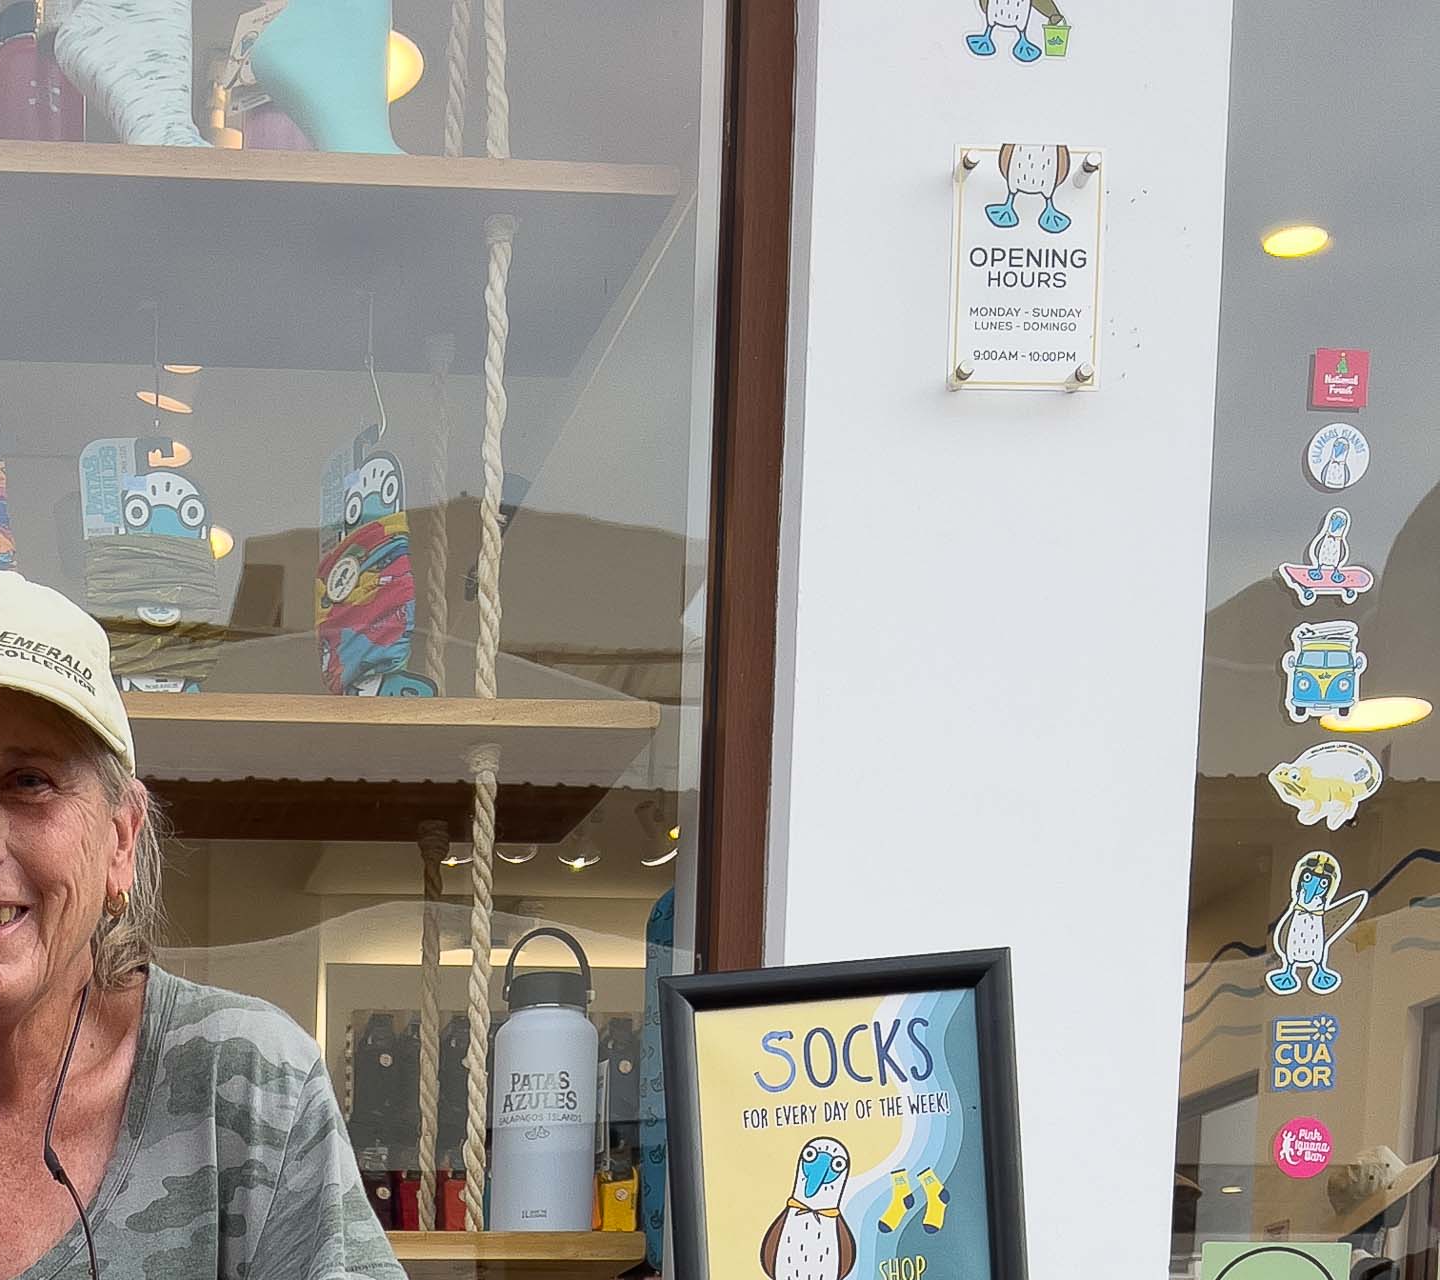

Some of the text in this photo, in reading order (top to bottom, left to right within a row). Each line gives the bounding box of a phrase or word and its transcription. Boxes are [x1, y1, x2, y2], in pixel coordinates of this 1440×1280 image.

[969, 247, 1087, 269] OPENING
[987, 271, 1067, 288] HOURS
[969, 306, 1021, 317] MONDAY
[1031, 307, 1082, 318] SUNDAY
[974, 321, 1013, 331] LUNES
[1023, 322, 1077, 331] DOMINGO
[973, 350, 1018, 361] 9:00AM
[1028, 351, 1076, 362] 10:00PM
[1312, 428, 1366, 465] GALAPAGOS ISLANDS
[754, 1017, 935, 1094] SOCKS
[1274, 1043, 1332, 1065] CUA
[510, 1071, 570, 1093] PATAS
[1274, 1066, 1332, 1088] DOR
[502, 1091, 578, 1114] AZULES
[743, 1091, 950, 1129] FOR EVERY DAY OF THE WEEK!
[1298, 1128, 1323, 1142] Pink
[1294, 1139, 1331, 1155] Iguana
